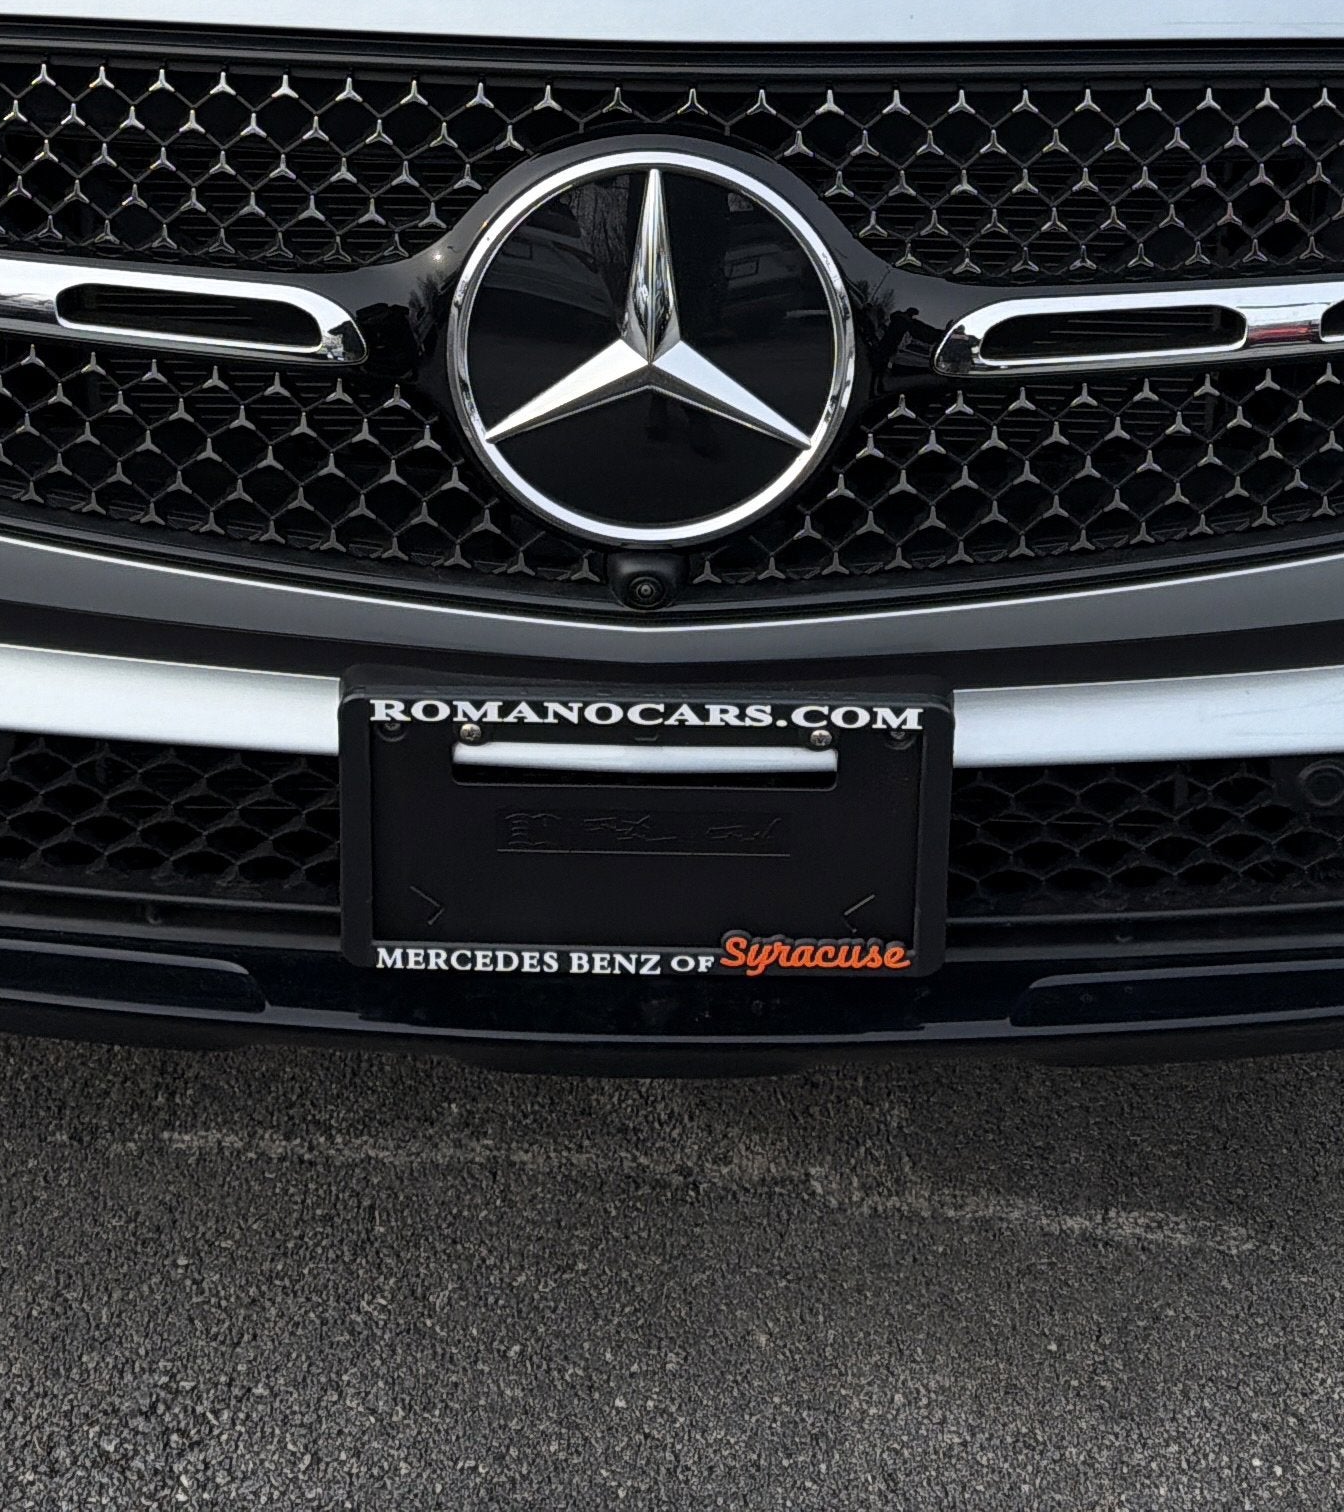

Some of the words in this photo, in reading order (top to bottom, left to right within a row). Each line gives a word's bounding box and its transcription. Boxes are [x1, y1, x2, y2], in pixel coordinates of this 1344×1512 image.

[369, 698, 925, 731] ROMANOCARS.COM
[376, 947, 560, 975] MERCEDES
[568, 950, 662, 975] BENZ
[671, 954, 716, 974] OF
[720, 936, 912, 978] Syracuse
